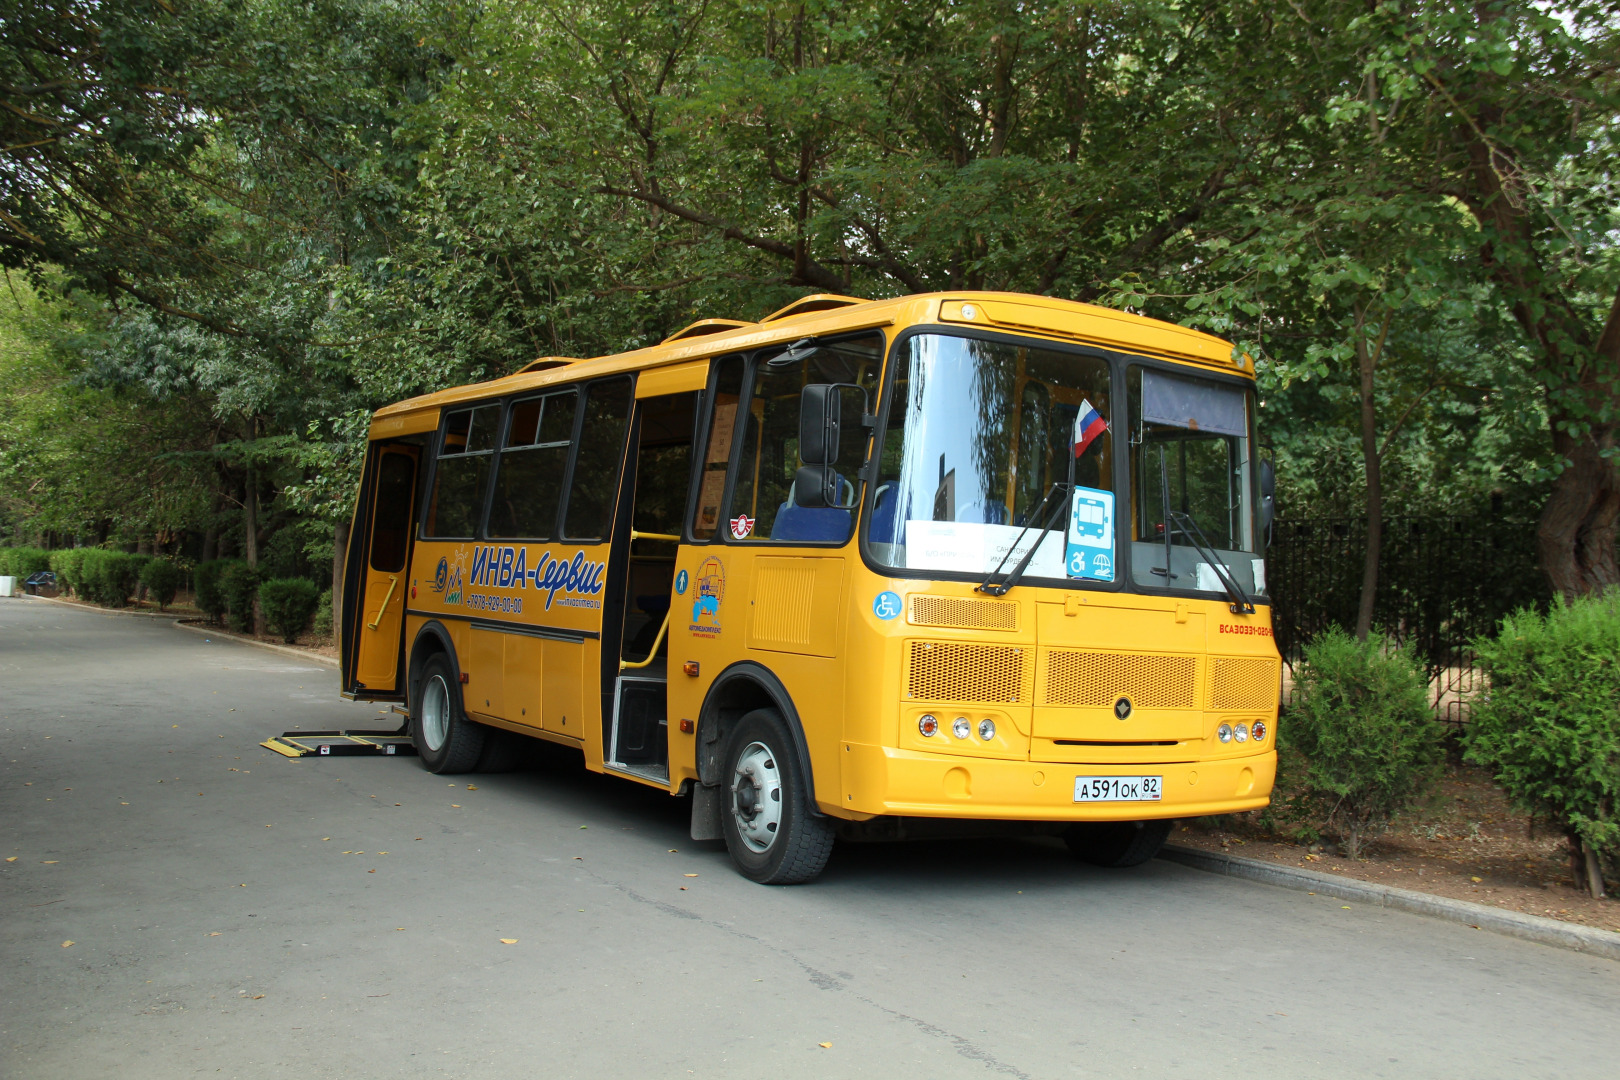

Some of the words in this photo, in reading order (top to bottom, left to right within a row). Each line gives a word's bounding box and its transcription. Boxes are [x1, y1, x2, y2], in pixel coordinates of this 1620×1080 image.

[470, 546, 605, 611] ИНВА-Сервис
[466, 594, 523, 613] +7978-929-00-00
[1143, 778, 1157, 792] 82
